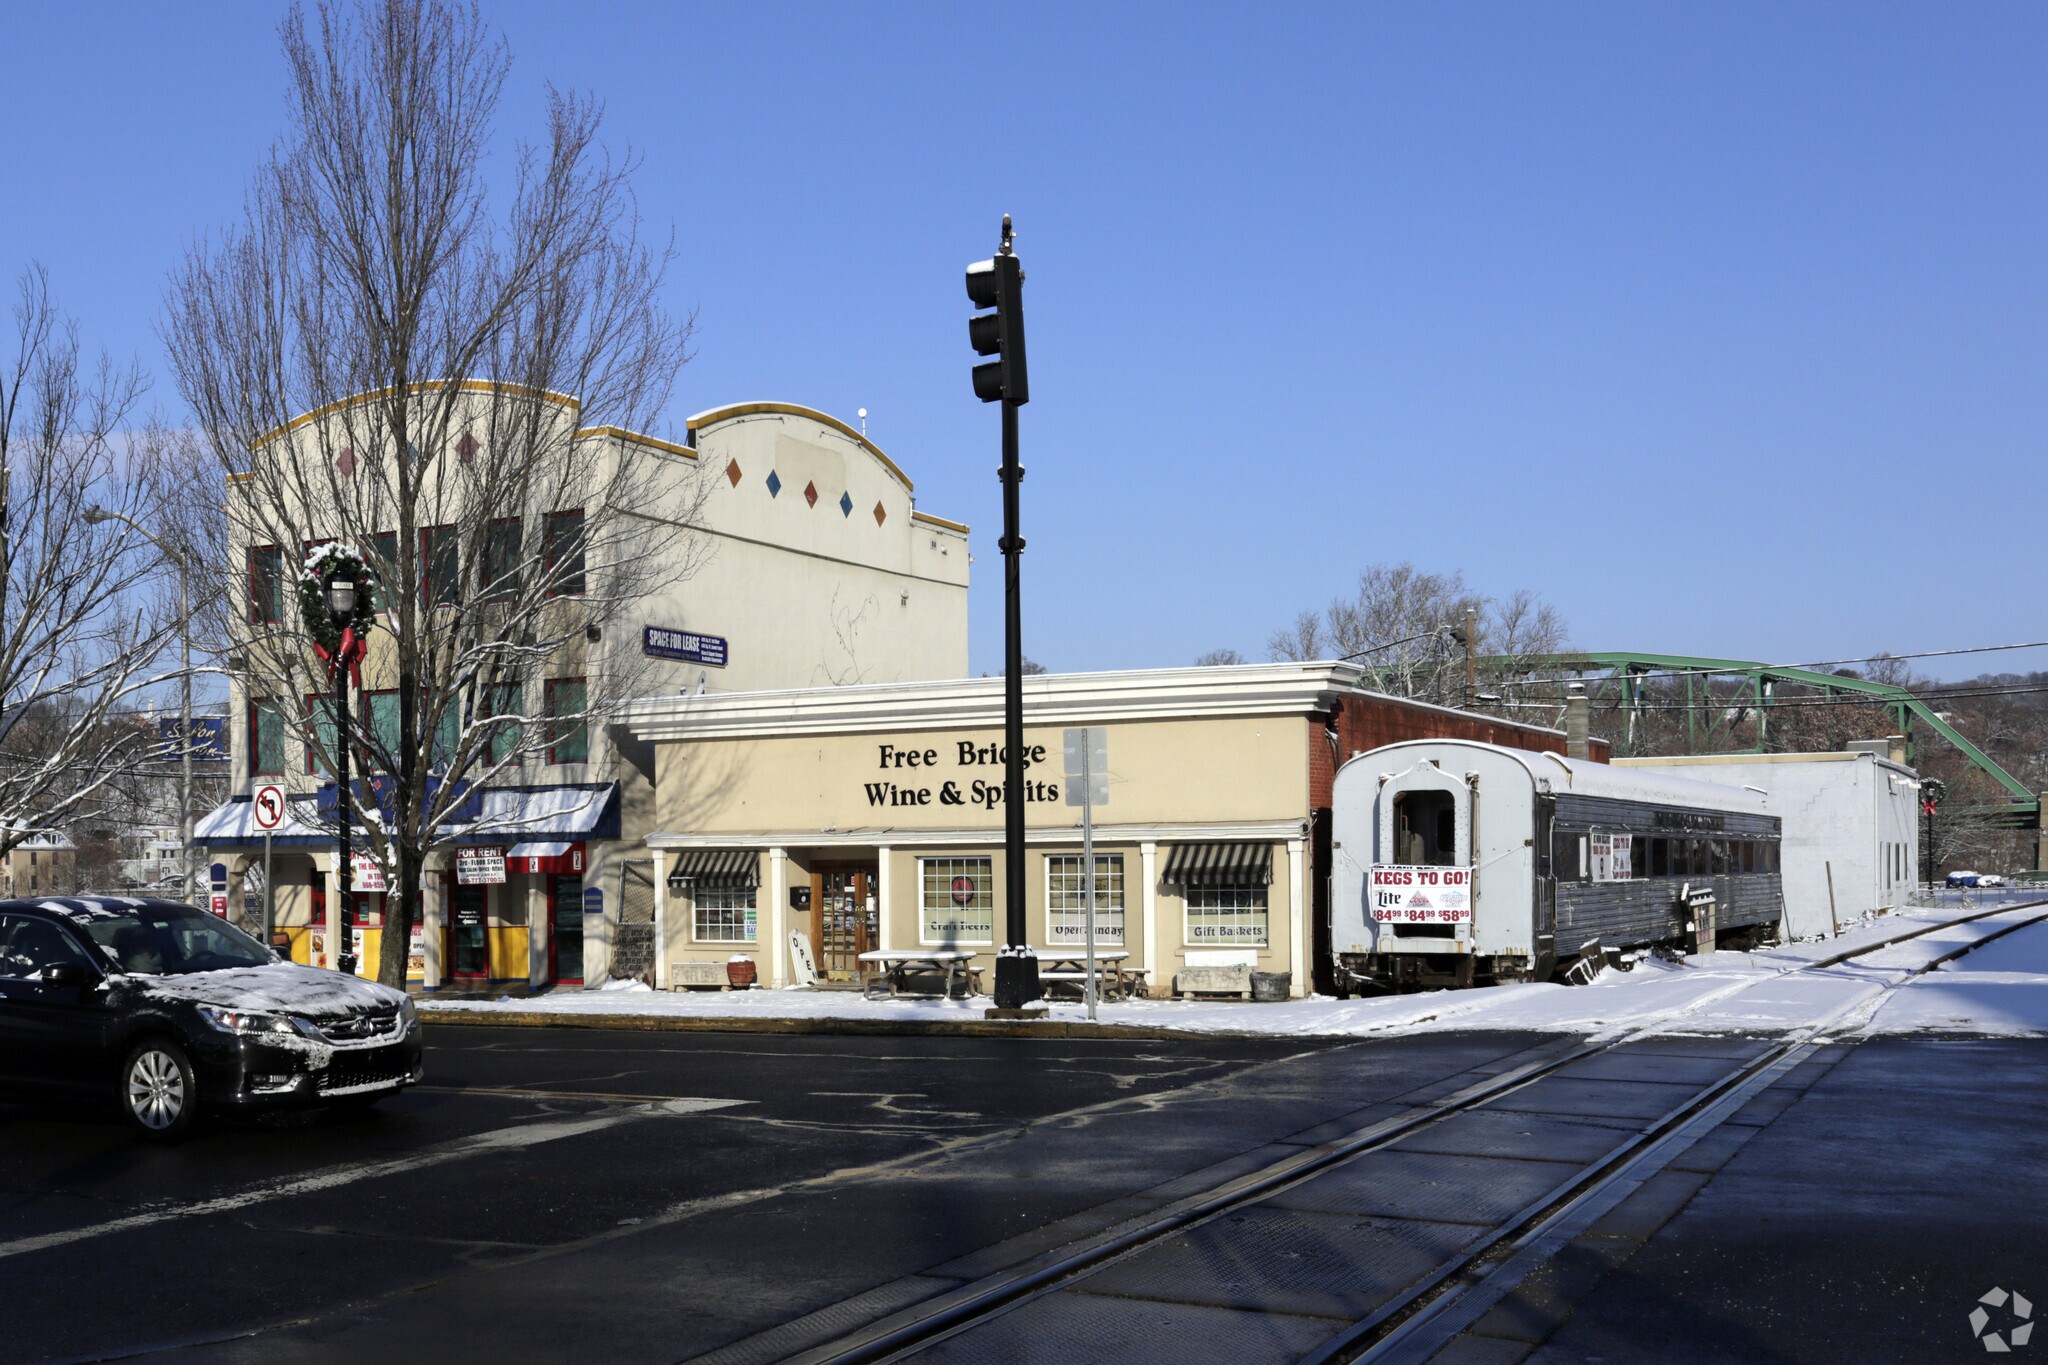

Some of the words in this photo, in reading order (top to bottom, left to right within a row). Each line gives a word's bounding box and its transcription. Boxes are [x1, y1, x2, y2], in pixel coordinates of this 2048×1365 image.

[649, 629, 669, 648] SPACE
[670, 632, 682, 650] FOR
[682, 634, 700, 652] LEASE
[879, 744, 938, 769] Free
[864, 782, 931, 807] Wine
[939, 780, 966, 805] &
[970, 779, 1059, 810] Spiits
[457, 848, 476, 858] FOR
[477, 847, 503, 857] RENT
[1374, 871, 1413, 886] KEGS
[1417, 871, 1439, 886] TO
[1443, 871, 1469, 886] GO!
[1378, 891, 1402, 908] Lite
[930, 921, 957, 931] Craft
[960, 921, 990, 931] Beers
[1194, 926, 1216, 937] Gift
[1219, 926, 1263, 936] Baskets
